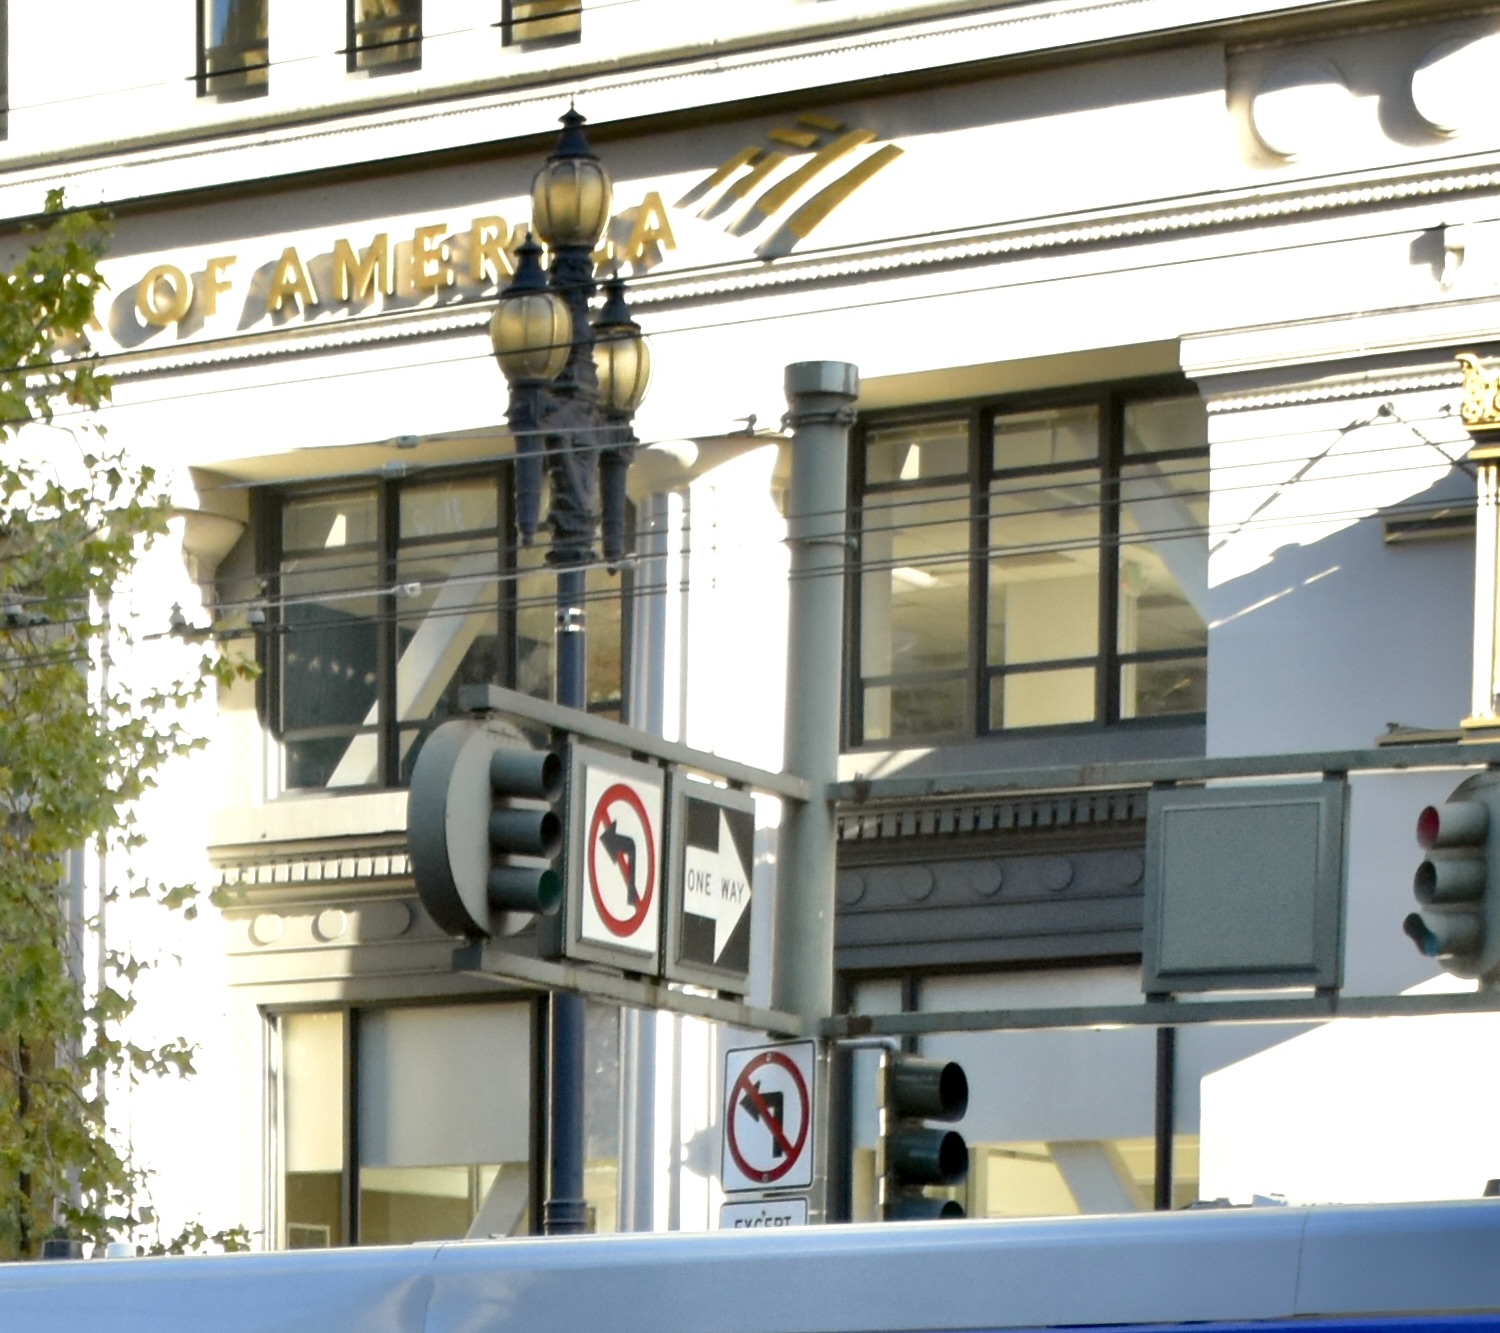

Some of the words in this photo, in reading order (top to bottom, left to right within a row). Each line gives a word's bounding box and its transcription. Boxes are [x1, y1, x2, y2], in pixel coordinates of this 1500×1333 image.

[135, 255, 238, 327] OF
[264, 190, 679, 312] AMERA
[687, 868, 712, 896] ONE
[720, 878, 745, 903] WAY
